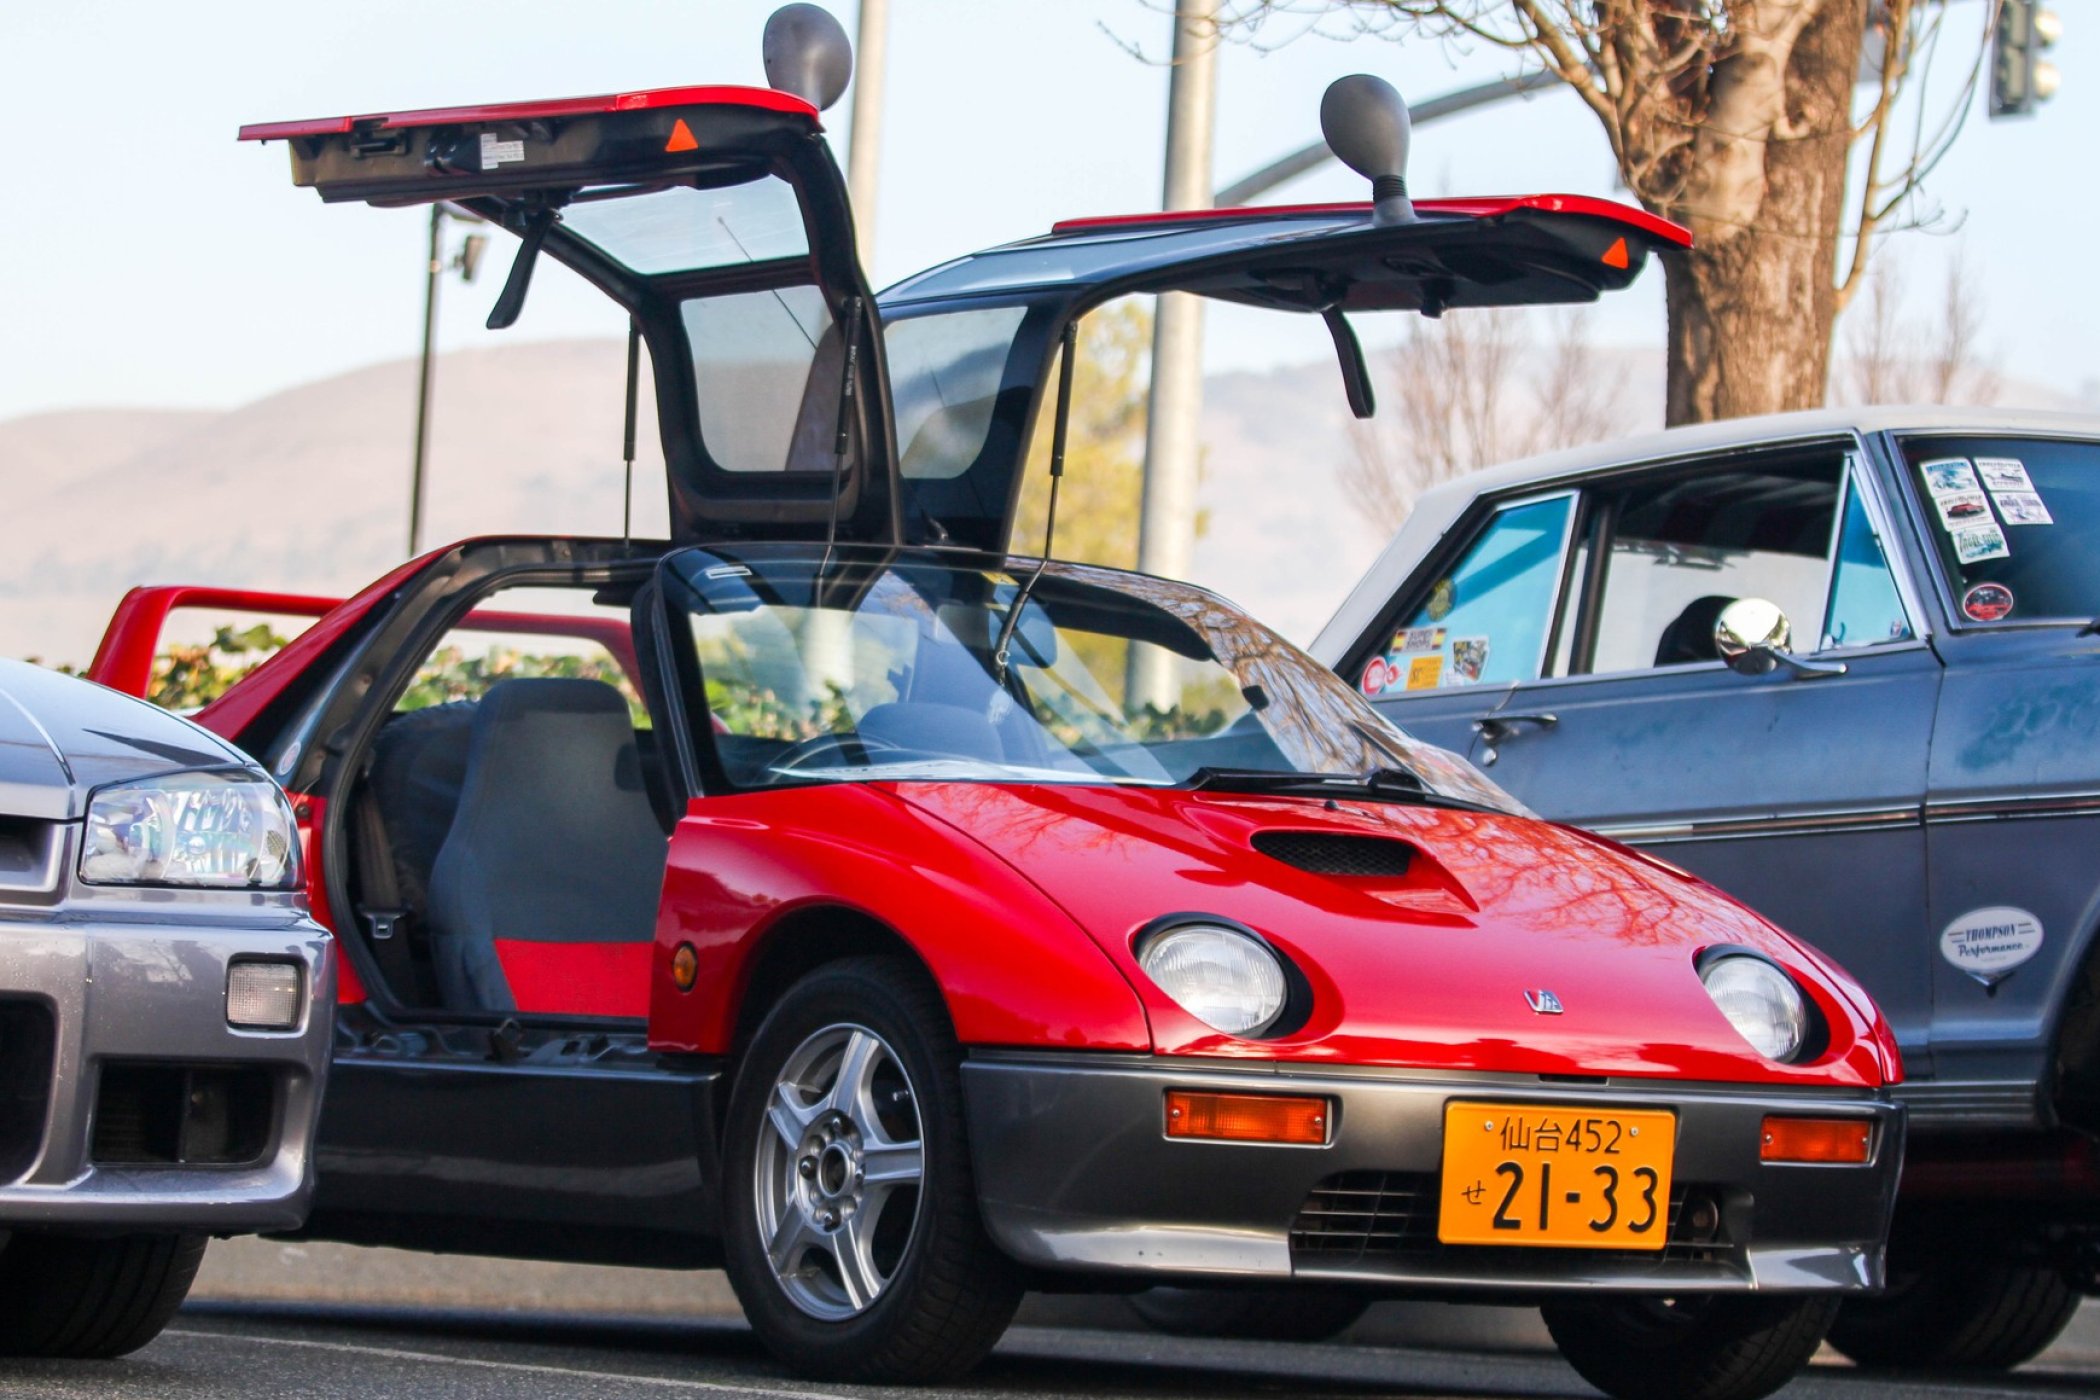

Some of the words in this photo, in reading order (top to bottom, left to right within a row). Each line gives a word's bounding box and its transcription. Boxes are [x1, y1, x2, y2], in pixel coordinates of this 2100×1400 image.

[1965, 923, 2015, 942] THOMPSON
[1958, 943, 2022, 957] Performance
[1462, 1181, 1486, 1204] せ
[1493, 1162, 1658, 1233] 21-33
